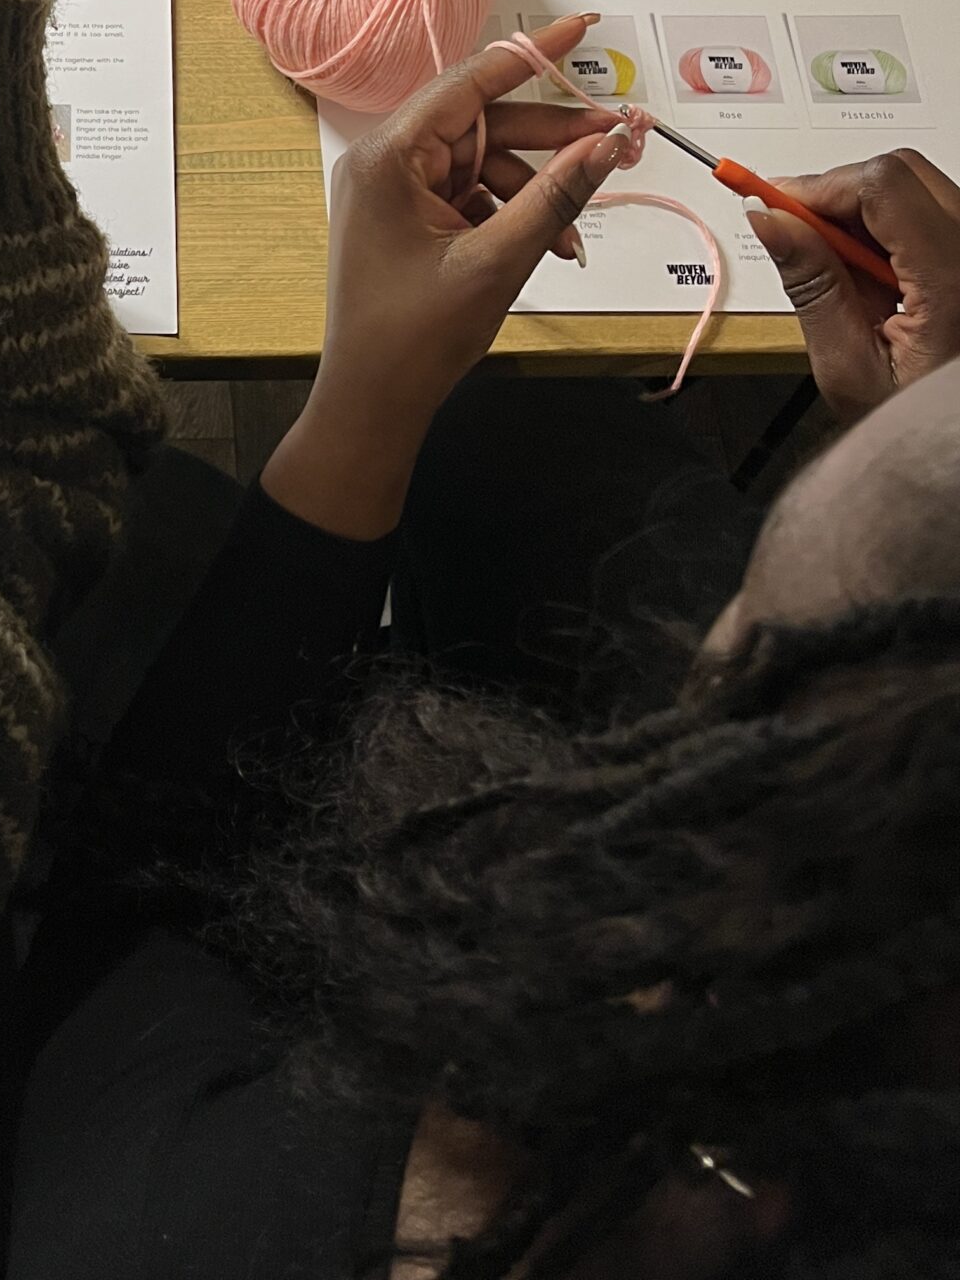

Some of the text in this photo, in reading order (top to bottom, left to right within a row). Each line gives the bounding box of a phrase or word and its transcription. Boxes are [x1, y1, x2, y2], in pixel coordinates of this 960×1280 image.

[719, 111, 743, 119] Rose
[841, 111, 894, 119] Pistachio
[108, 247, 152, 257] ulations!
[667, 264, 706, 275] WOVEN
[677, 274, 714, 285] BEYON
